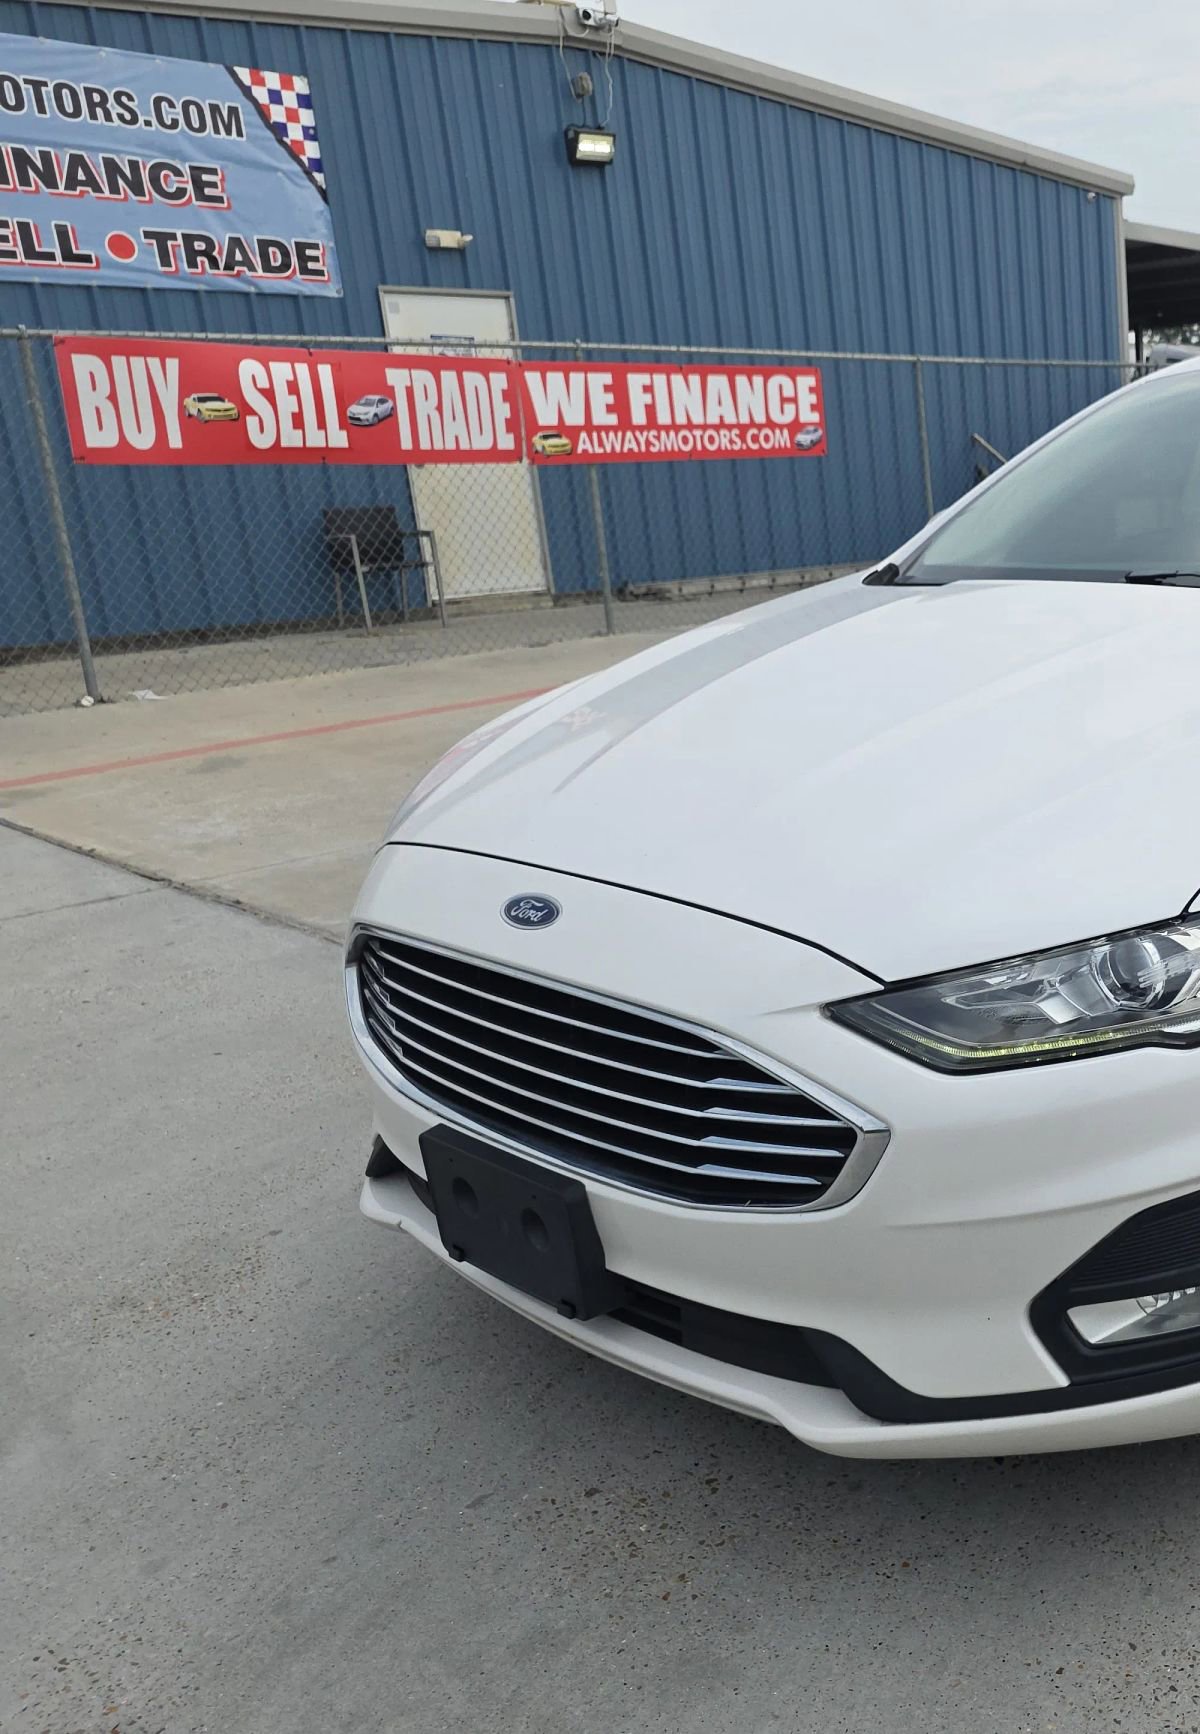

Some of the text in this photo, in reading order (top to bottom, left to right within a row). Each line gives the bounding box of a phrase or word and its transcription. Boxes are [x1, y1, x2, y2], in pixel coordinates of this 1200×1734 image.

[0, 73, 245, 139] OTORS.COM
[142, 229, 329, 281] TRADE
[71, 353, 515, 451] BUY SELL TRADE
[524, 371, 820, 426] WE FINANCE
[576, 428, 791, 454] ALWAYSMOTORS.COM
[511, 899, 549, 922] Ford
